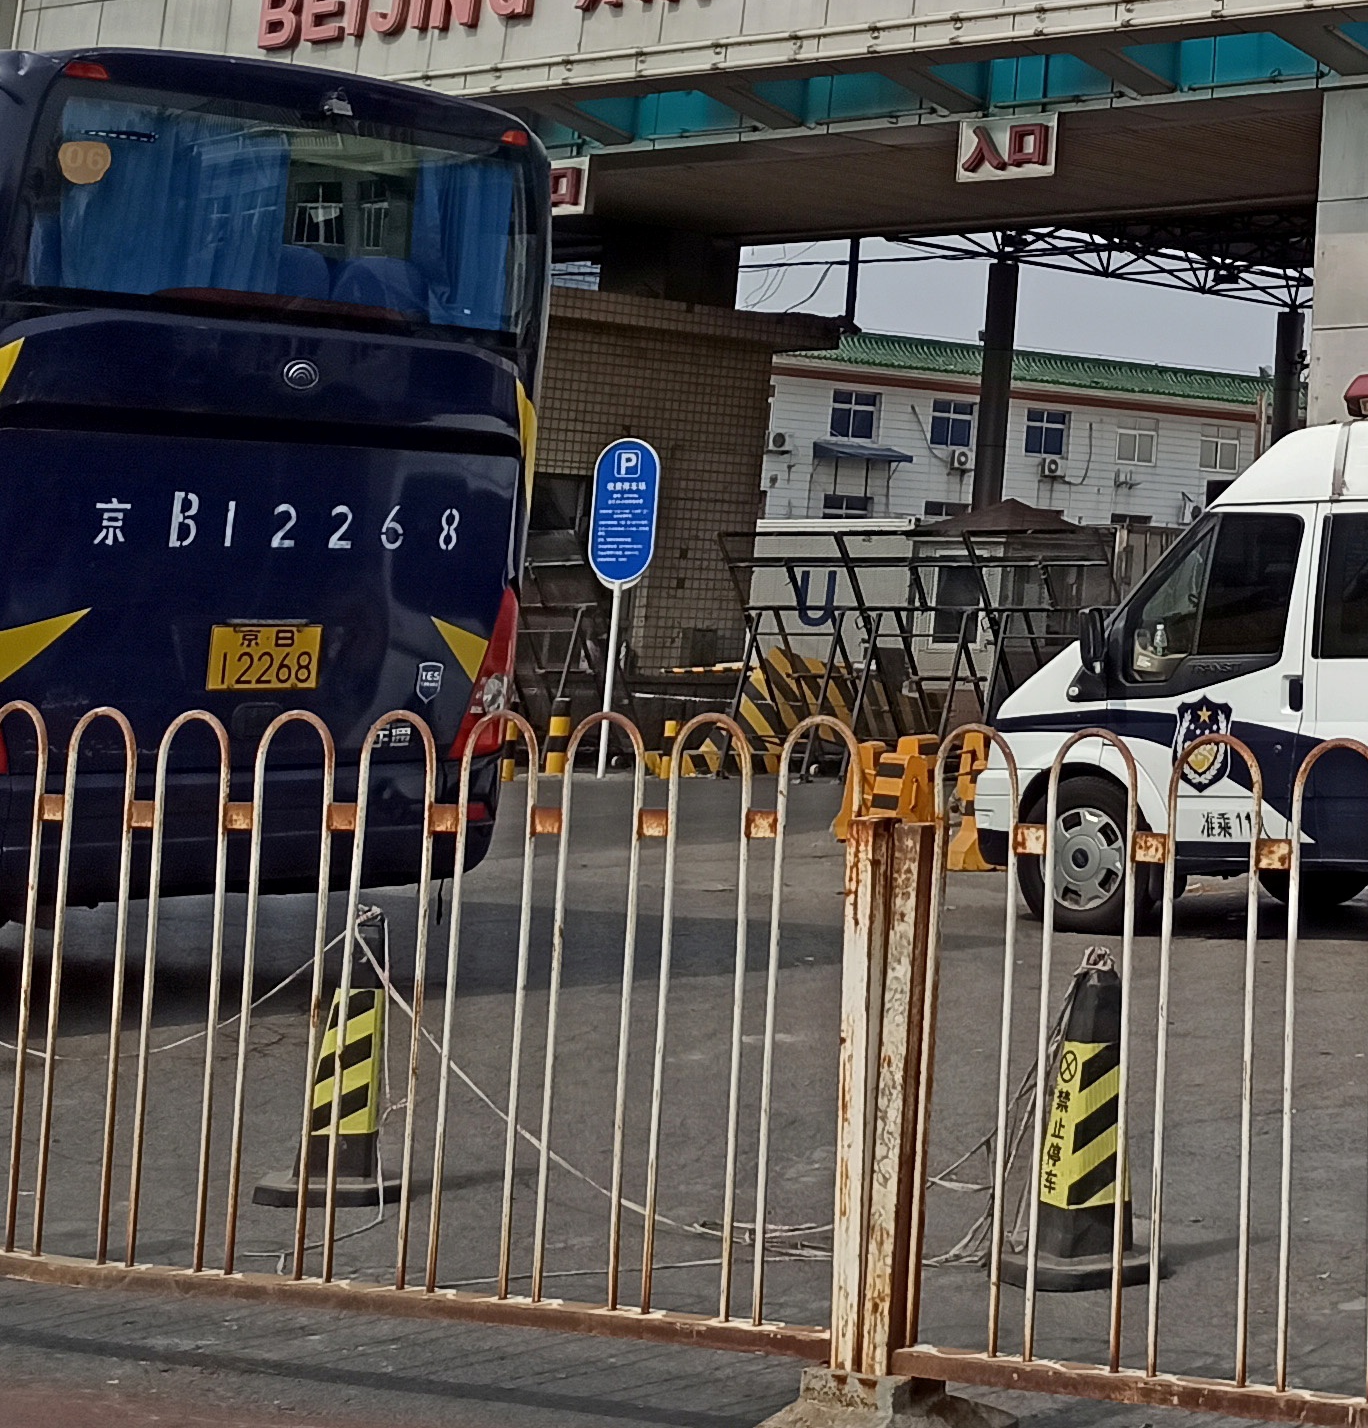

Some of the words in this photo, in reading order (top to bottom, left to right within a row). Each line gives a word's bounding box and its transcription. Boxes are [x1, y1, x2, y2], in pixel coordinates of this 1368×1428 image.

[962, 123, 1049, 172] 入口
[551, 166, 582, 207] 口
[220, 651, 313, 686] 12268
[1043, 1088, 1071, 1194] 禁止停车
